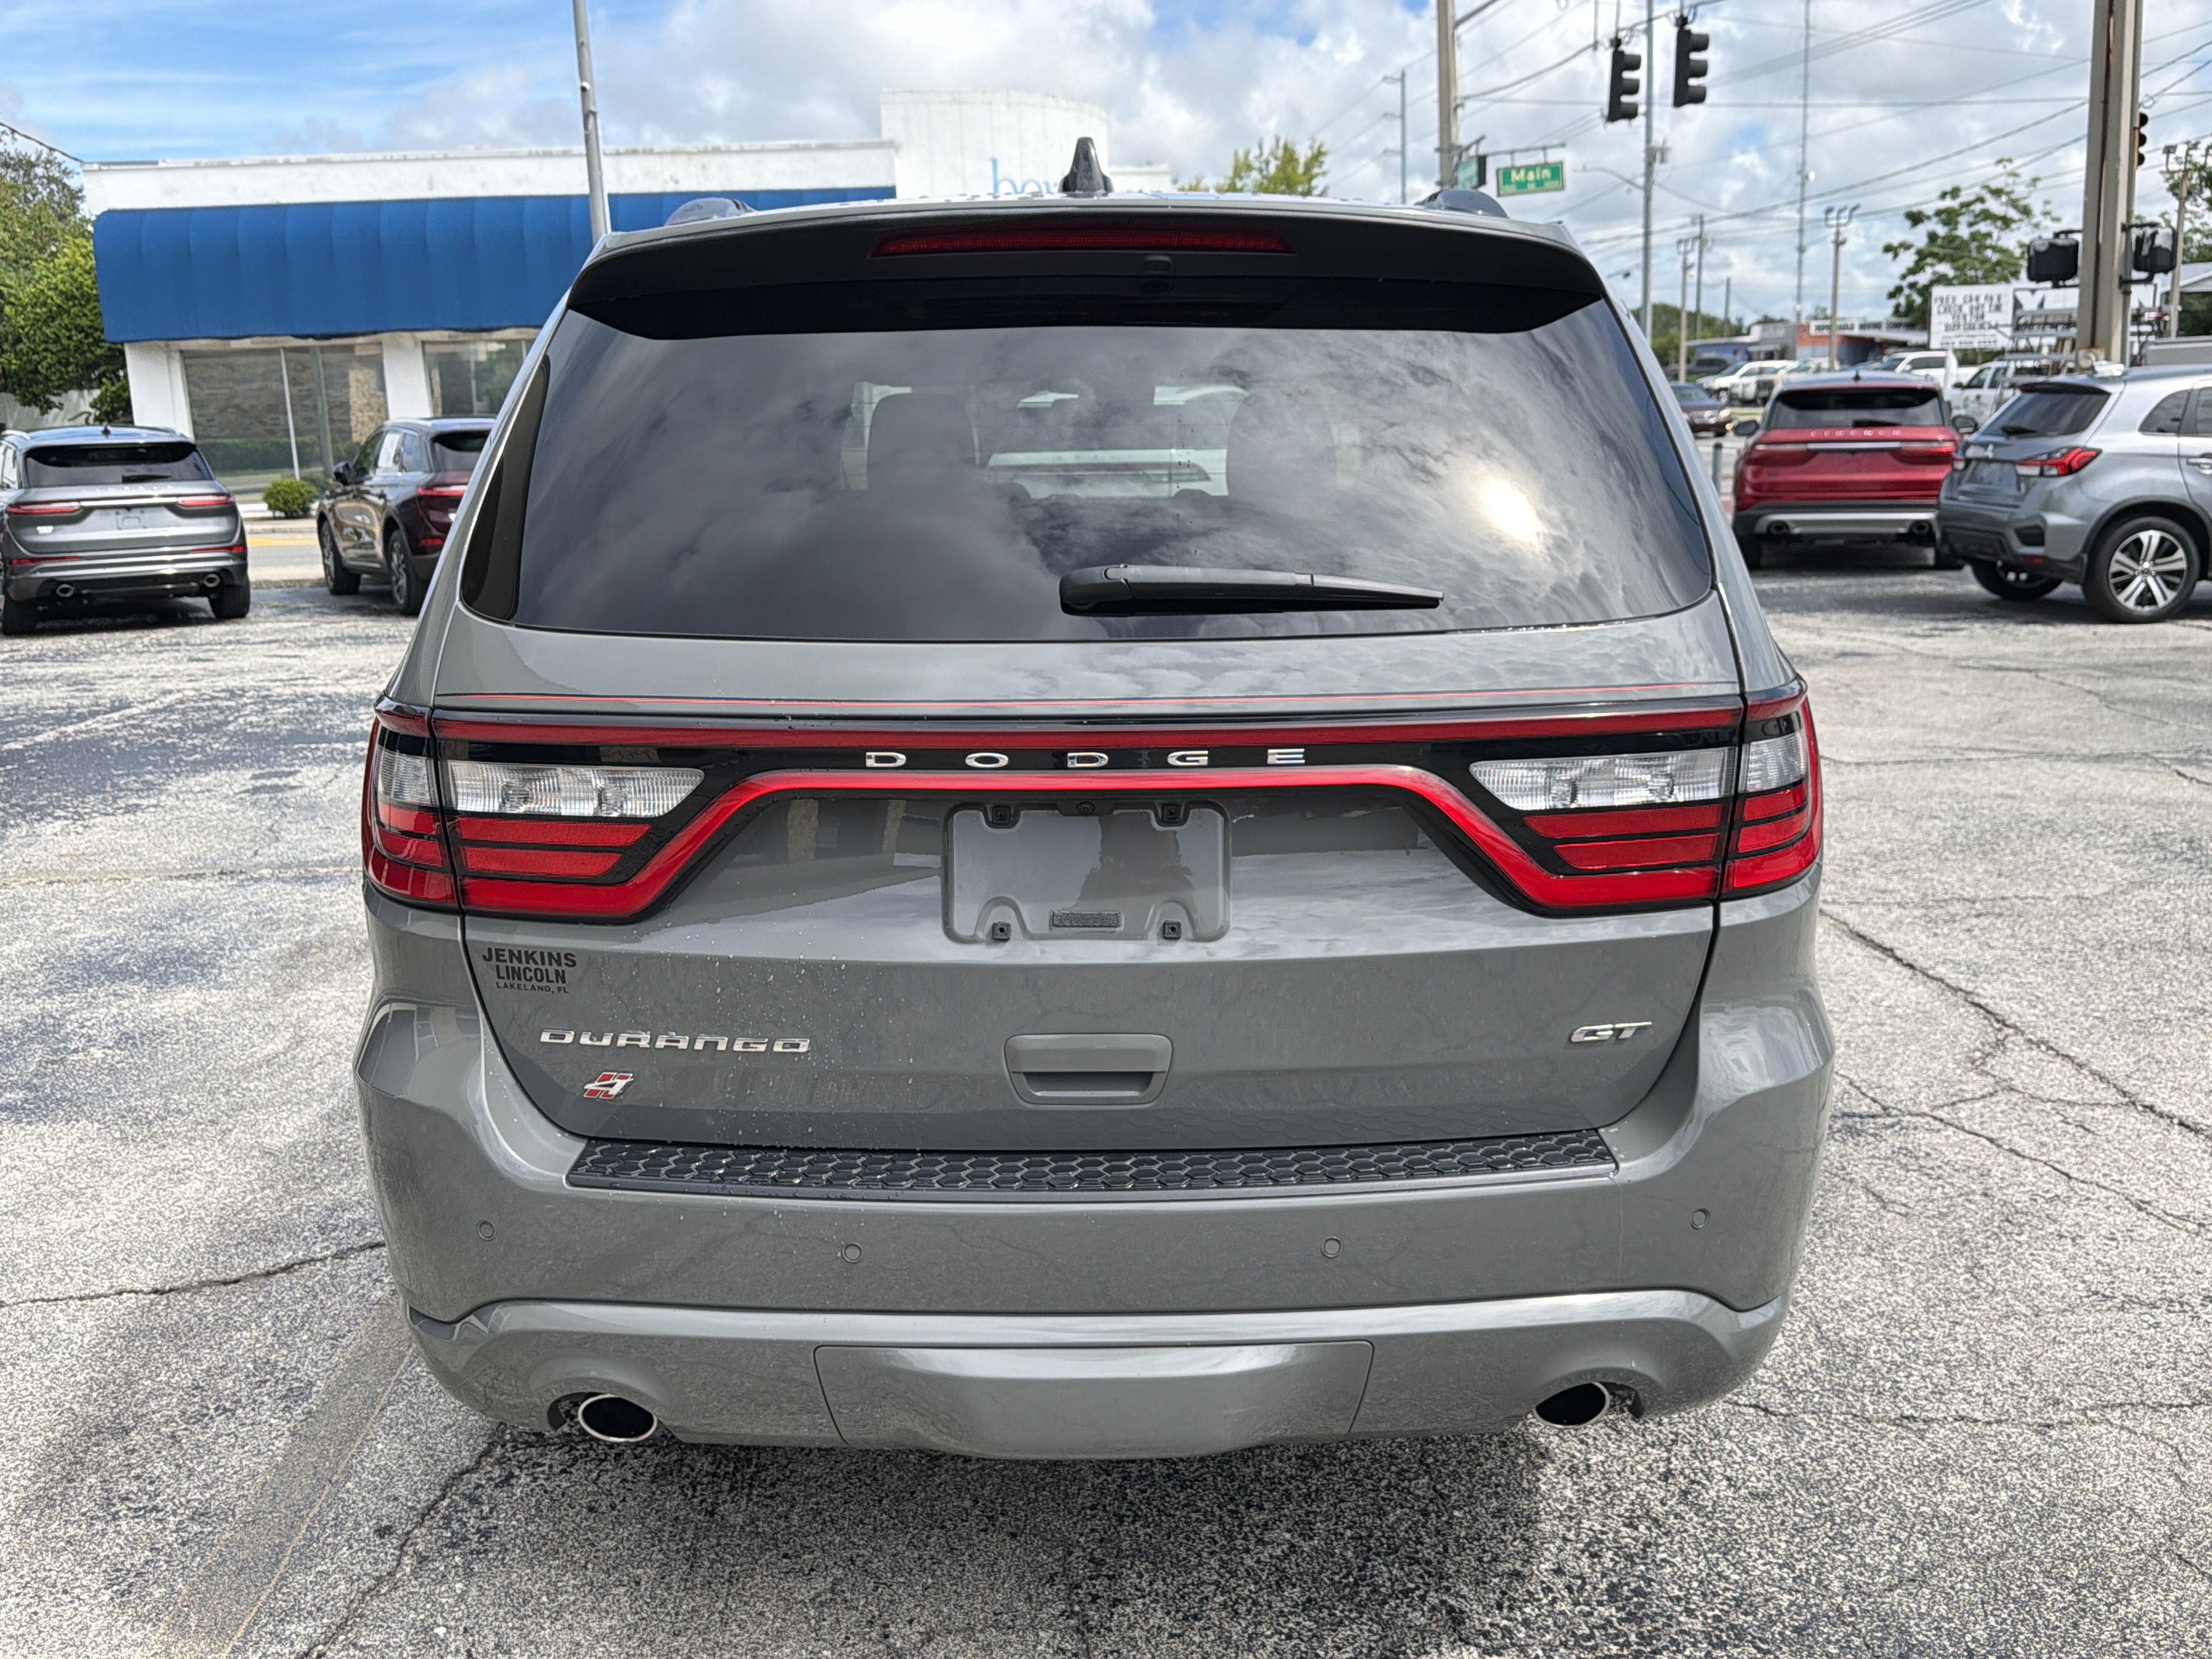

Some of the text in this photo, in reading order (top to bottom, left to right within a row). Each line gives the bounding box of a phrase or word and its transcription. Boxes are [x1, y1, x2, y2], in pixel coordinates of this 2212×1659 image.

[1511, 167, 1551, 182] Main
[865, 748, 1306, 769] DODGE
[482, 947, 577, 968] JENKINS
[495, 964, 567, 984] LINCOLN
[495, 981, 569, 994] LAKELAND, FL
[539, 1029, 811, 1053] DURANGO
[1570, 1021, 1653, 1043] GT
